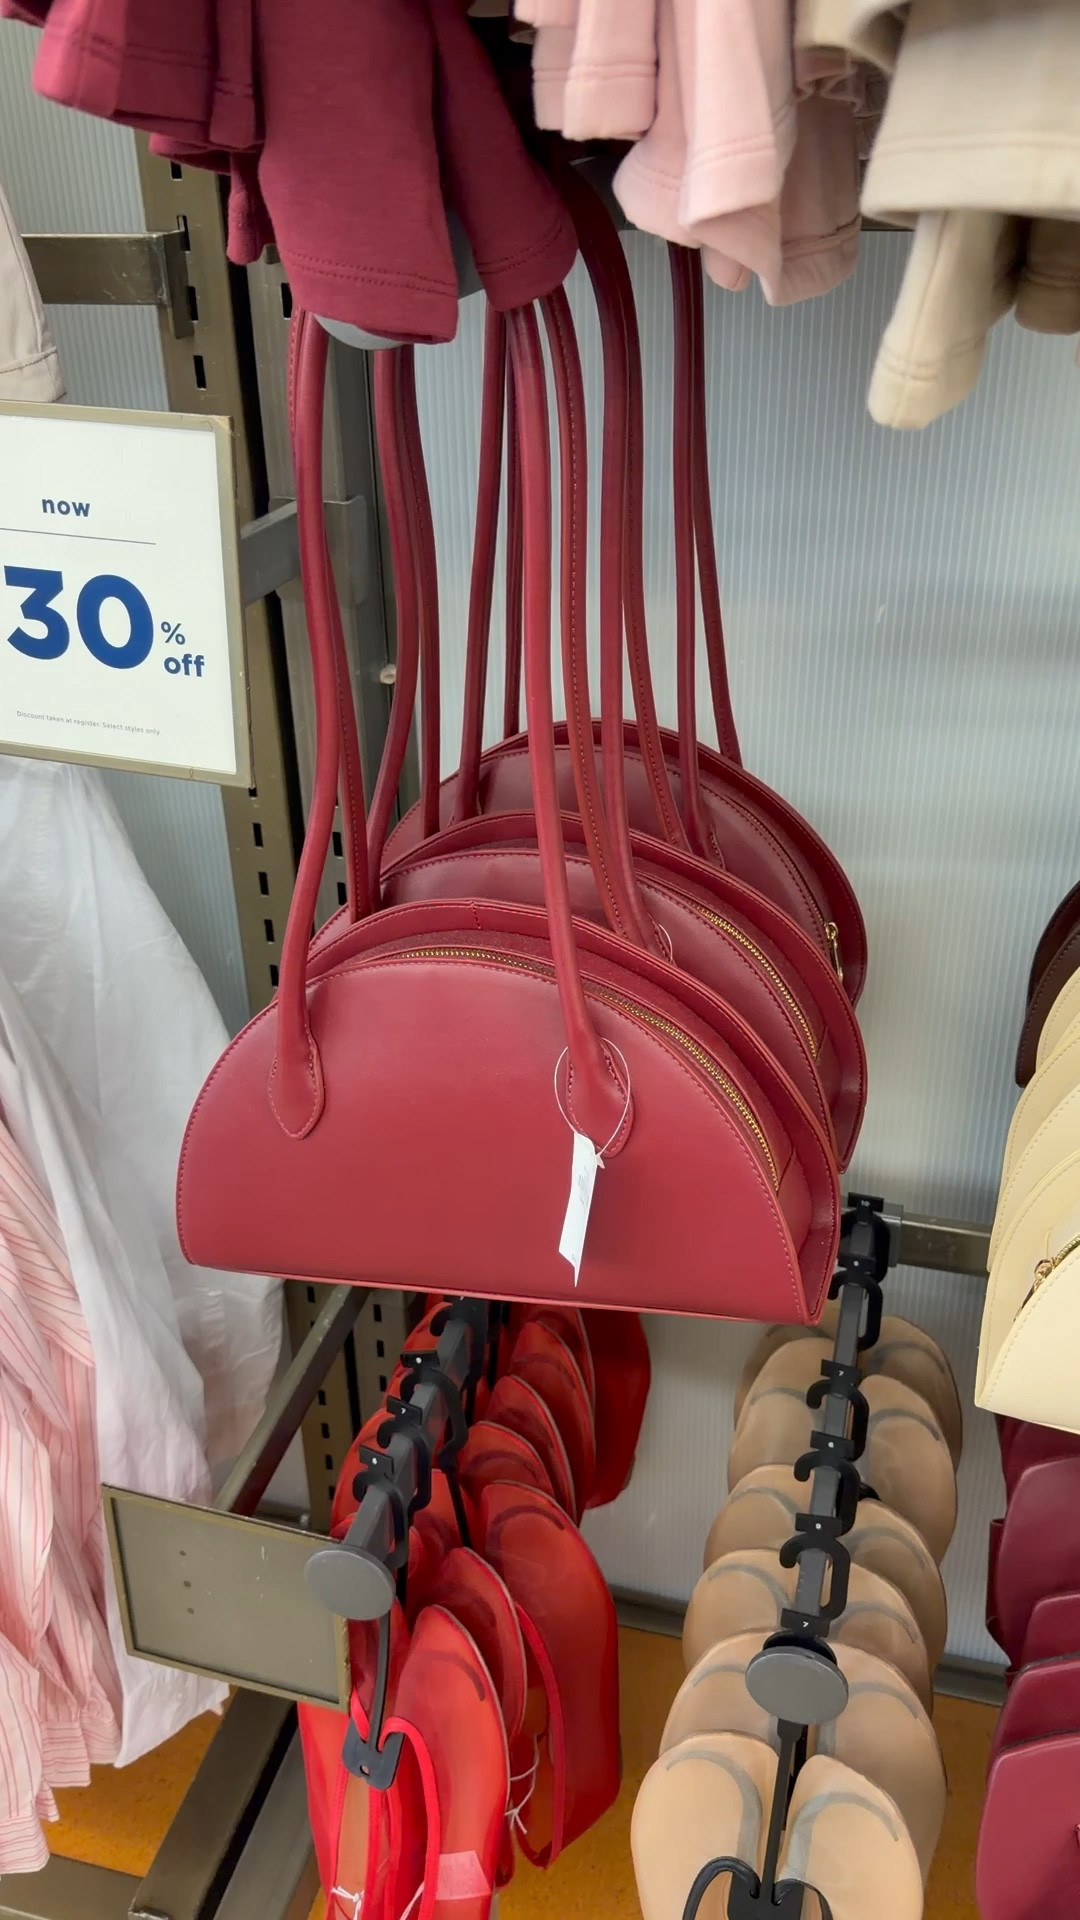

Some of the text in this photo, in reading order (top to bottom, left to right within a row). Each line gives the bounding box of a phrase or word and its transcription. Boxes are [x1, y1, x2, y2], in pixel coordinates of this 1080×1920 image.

[42, 498, 90, 517] now
[4, 565, 186, 669] 30 %
[164, 653, 205, 677] off
[16, 711, 45, 721] Discount
[46, 714, 65, 723] taken
[102, 721, 123, 731] Select
[124, 724, 144, 734] styles
